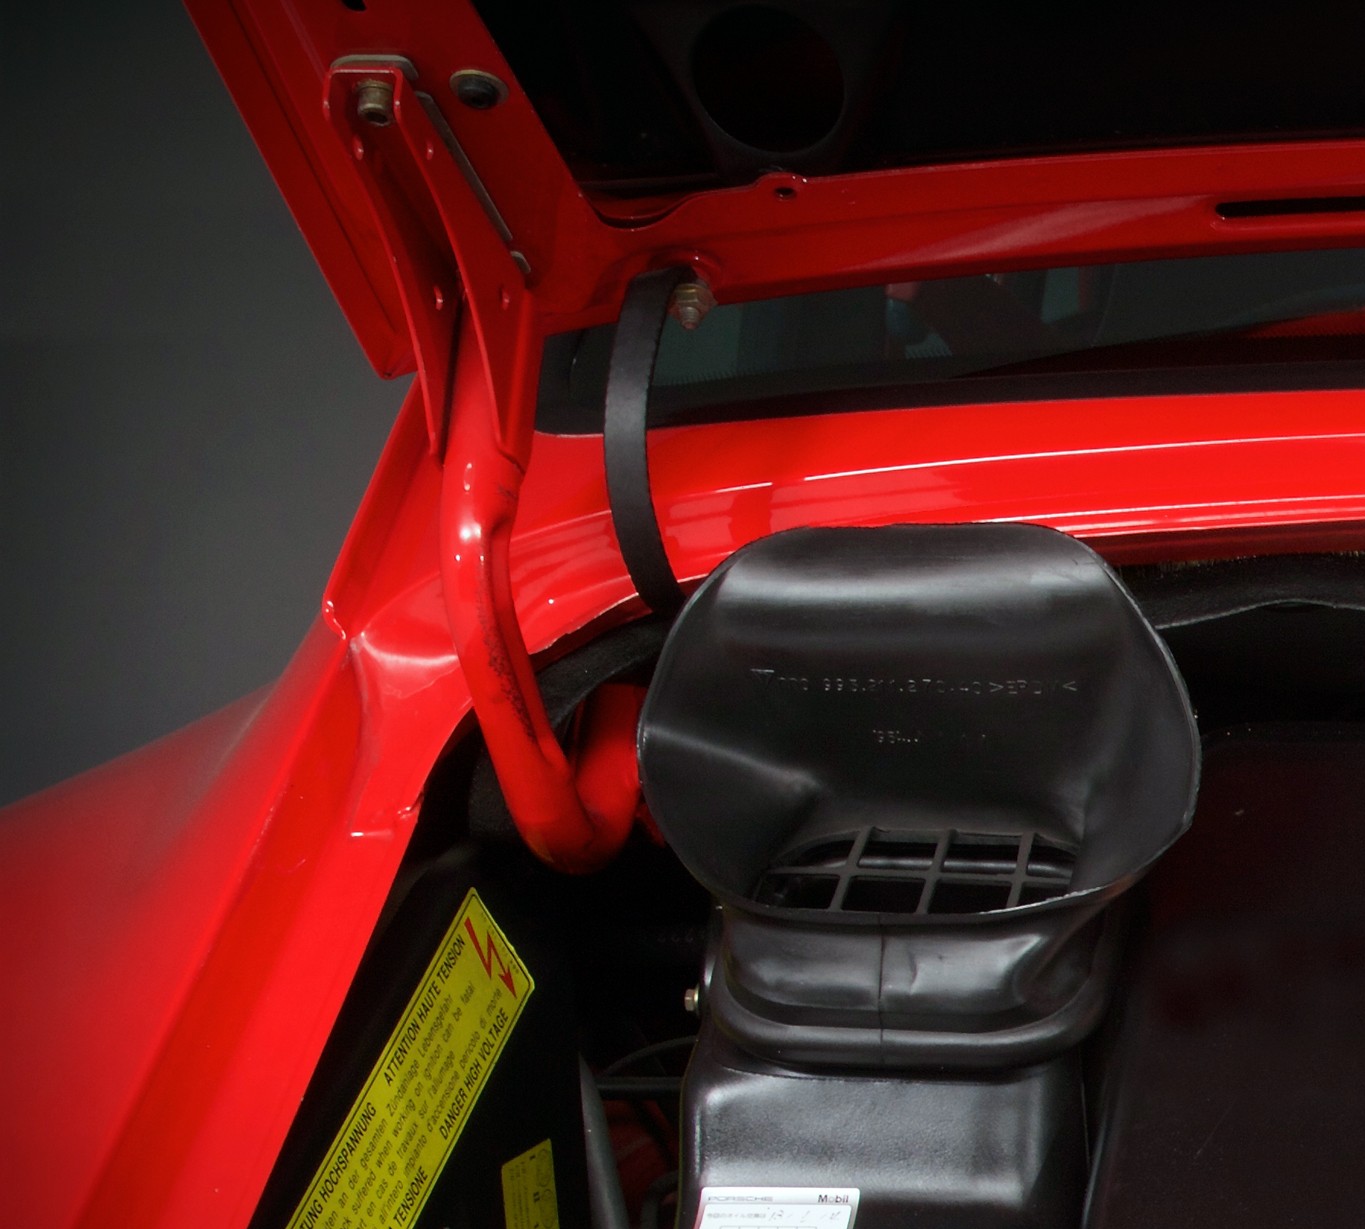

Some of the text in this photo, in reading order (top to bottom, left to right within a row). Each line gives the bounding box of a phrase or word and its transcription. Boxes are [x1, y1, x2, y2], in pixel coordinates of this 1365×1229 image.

[382, 933, 466, 1086] ATTENTION HAUTE TENSION
[438, 1086, 468, 1140] DANGER
[463, 1058, 482, 1093] HIGH
[478, 1007, 509, 1063] VOLTAGE
[318, 1099, 376, 1203] HOCHSPANNUNG
[338, 1190, 348, 1208] an
[345, 1165, 360, 1190] der
[358, 1115, 388, 1170] gesamten
[416, 990, 455, 1060] Lebensgefahr
[349, 1166, 376, 1215] suffered
[373, 1135, 392, 1169] when
[390, 1096, 415, 1140] working
[413, 1081, 423, 1098] on
[421, 1042, 444, 1083] ignition
[442, 1022, 454, 1044] can
[451, 1004, 463, 1023] be
[365, 1199, 376, 1217] en
[375, 1177, 388, 1200] cas
[385, 1156, 397, 1176] de
[396, 1118, 419, 1160] travaux
[417, 1095, 432, 1120] sur
[427, 1048, 456, 1100] l'allumage
[393, 1164, 427, 1228] TENSIONE
[818, 1194, 849, 1203] Mobil
